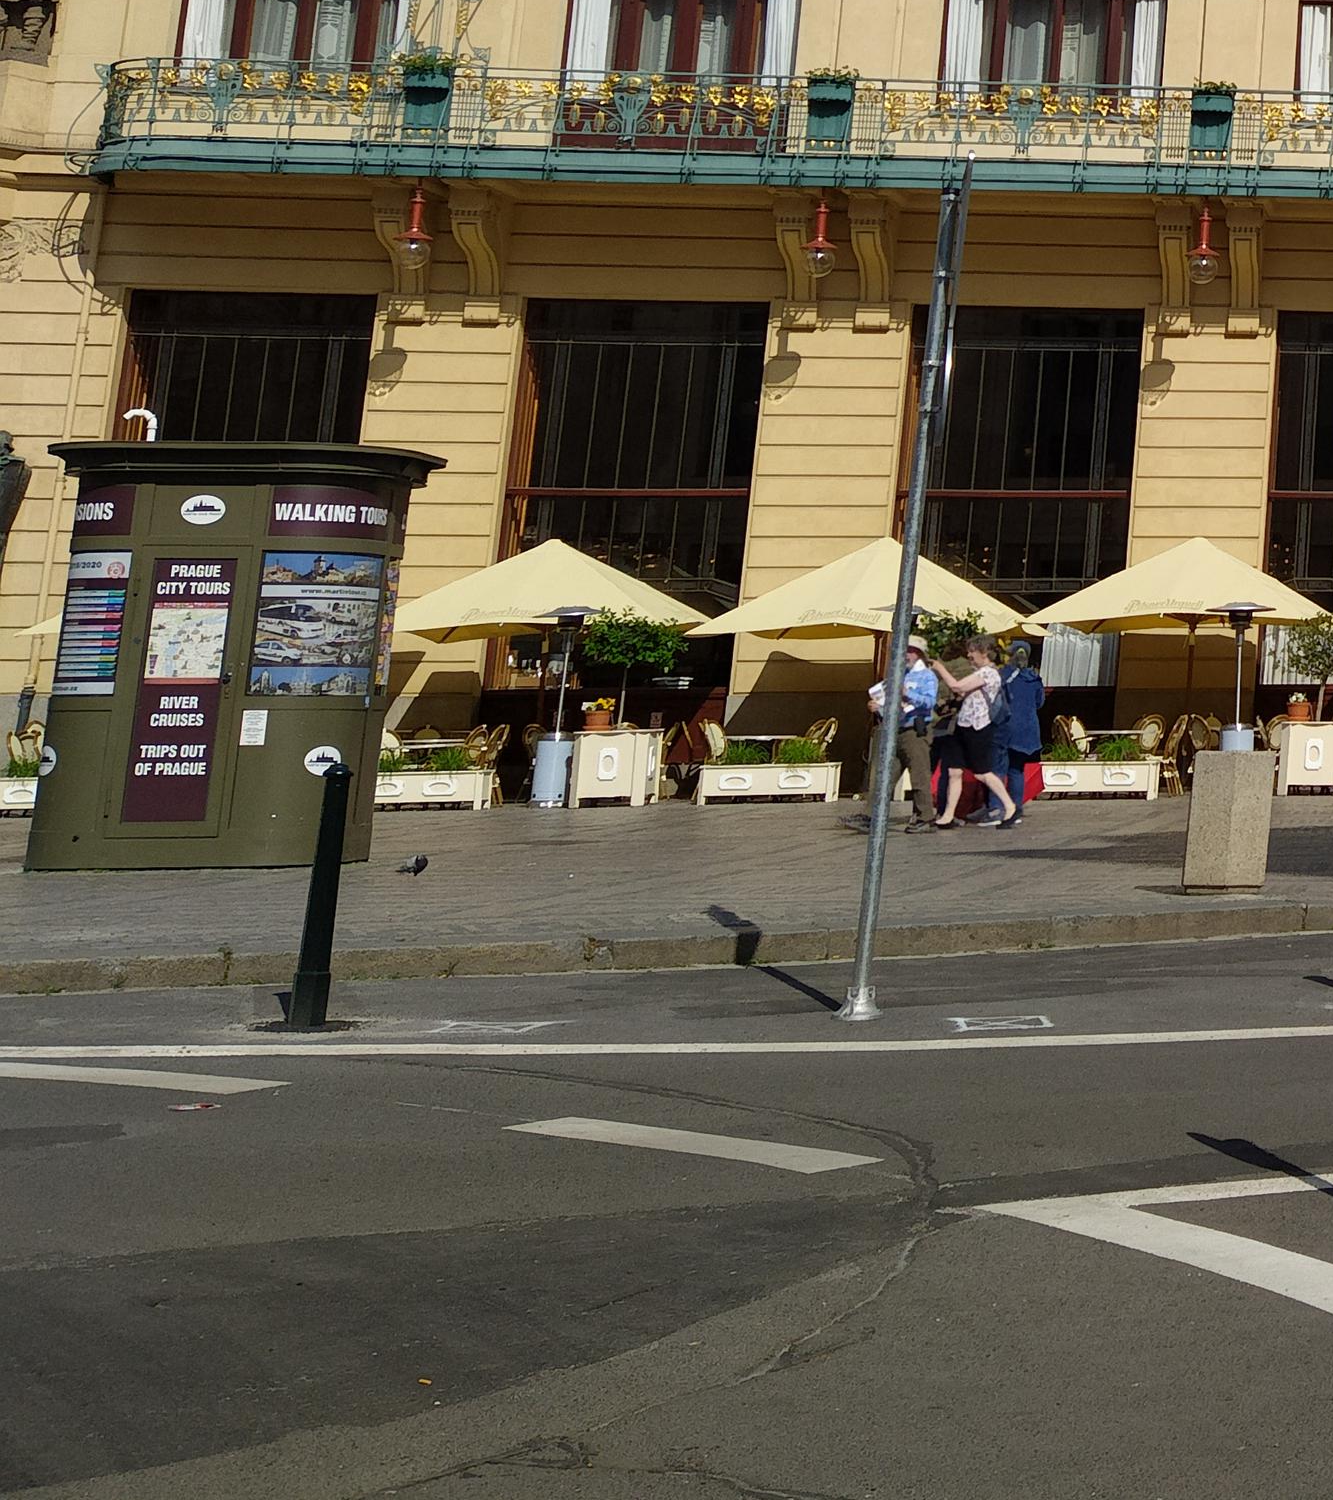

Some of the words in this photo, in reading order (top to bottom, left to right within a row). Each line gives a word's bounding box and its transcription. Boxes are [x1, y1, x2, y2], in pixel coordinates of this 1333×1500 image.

[274, 502, 356, 525] WALKING
[360, 506, 388, 527] TOURS
[170, 564, 222, 578] PRAGUE
[156, 582, 187, 595] CITY
[189, 581, 231, 595] TOURS
[159, 696, 199, 709] RIVER
[150, 713, 205, 727] CRUISES
[140, 745, 178, 758] TRIPS
[180, 744, 207, 758] OUT
[134, 763, 152, 776] OF
[154, 762, 207, 776] PRAGUE
